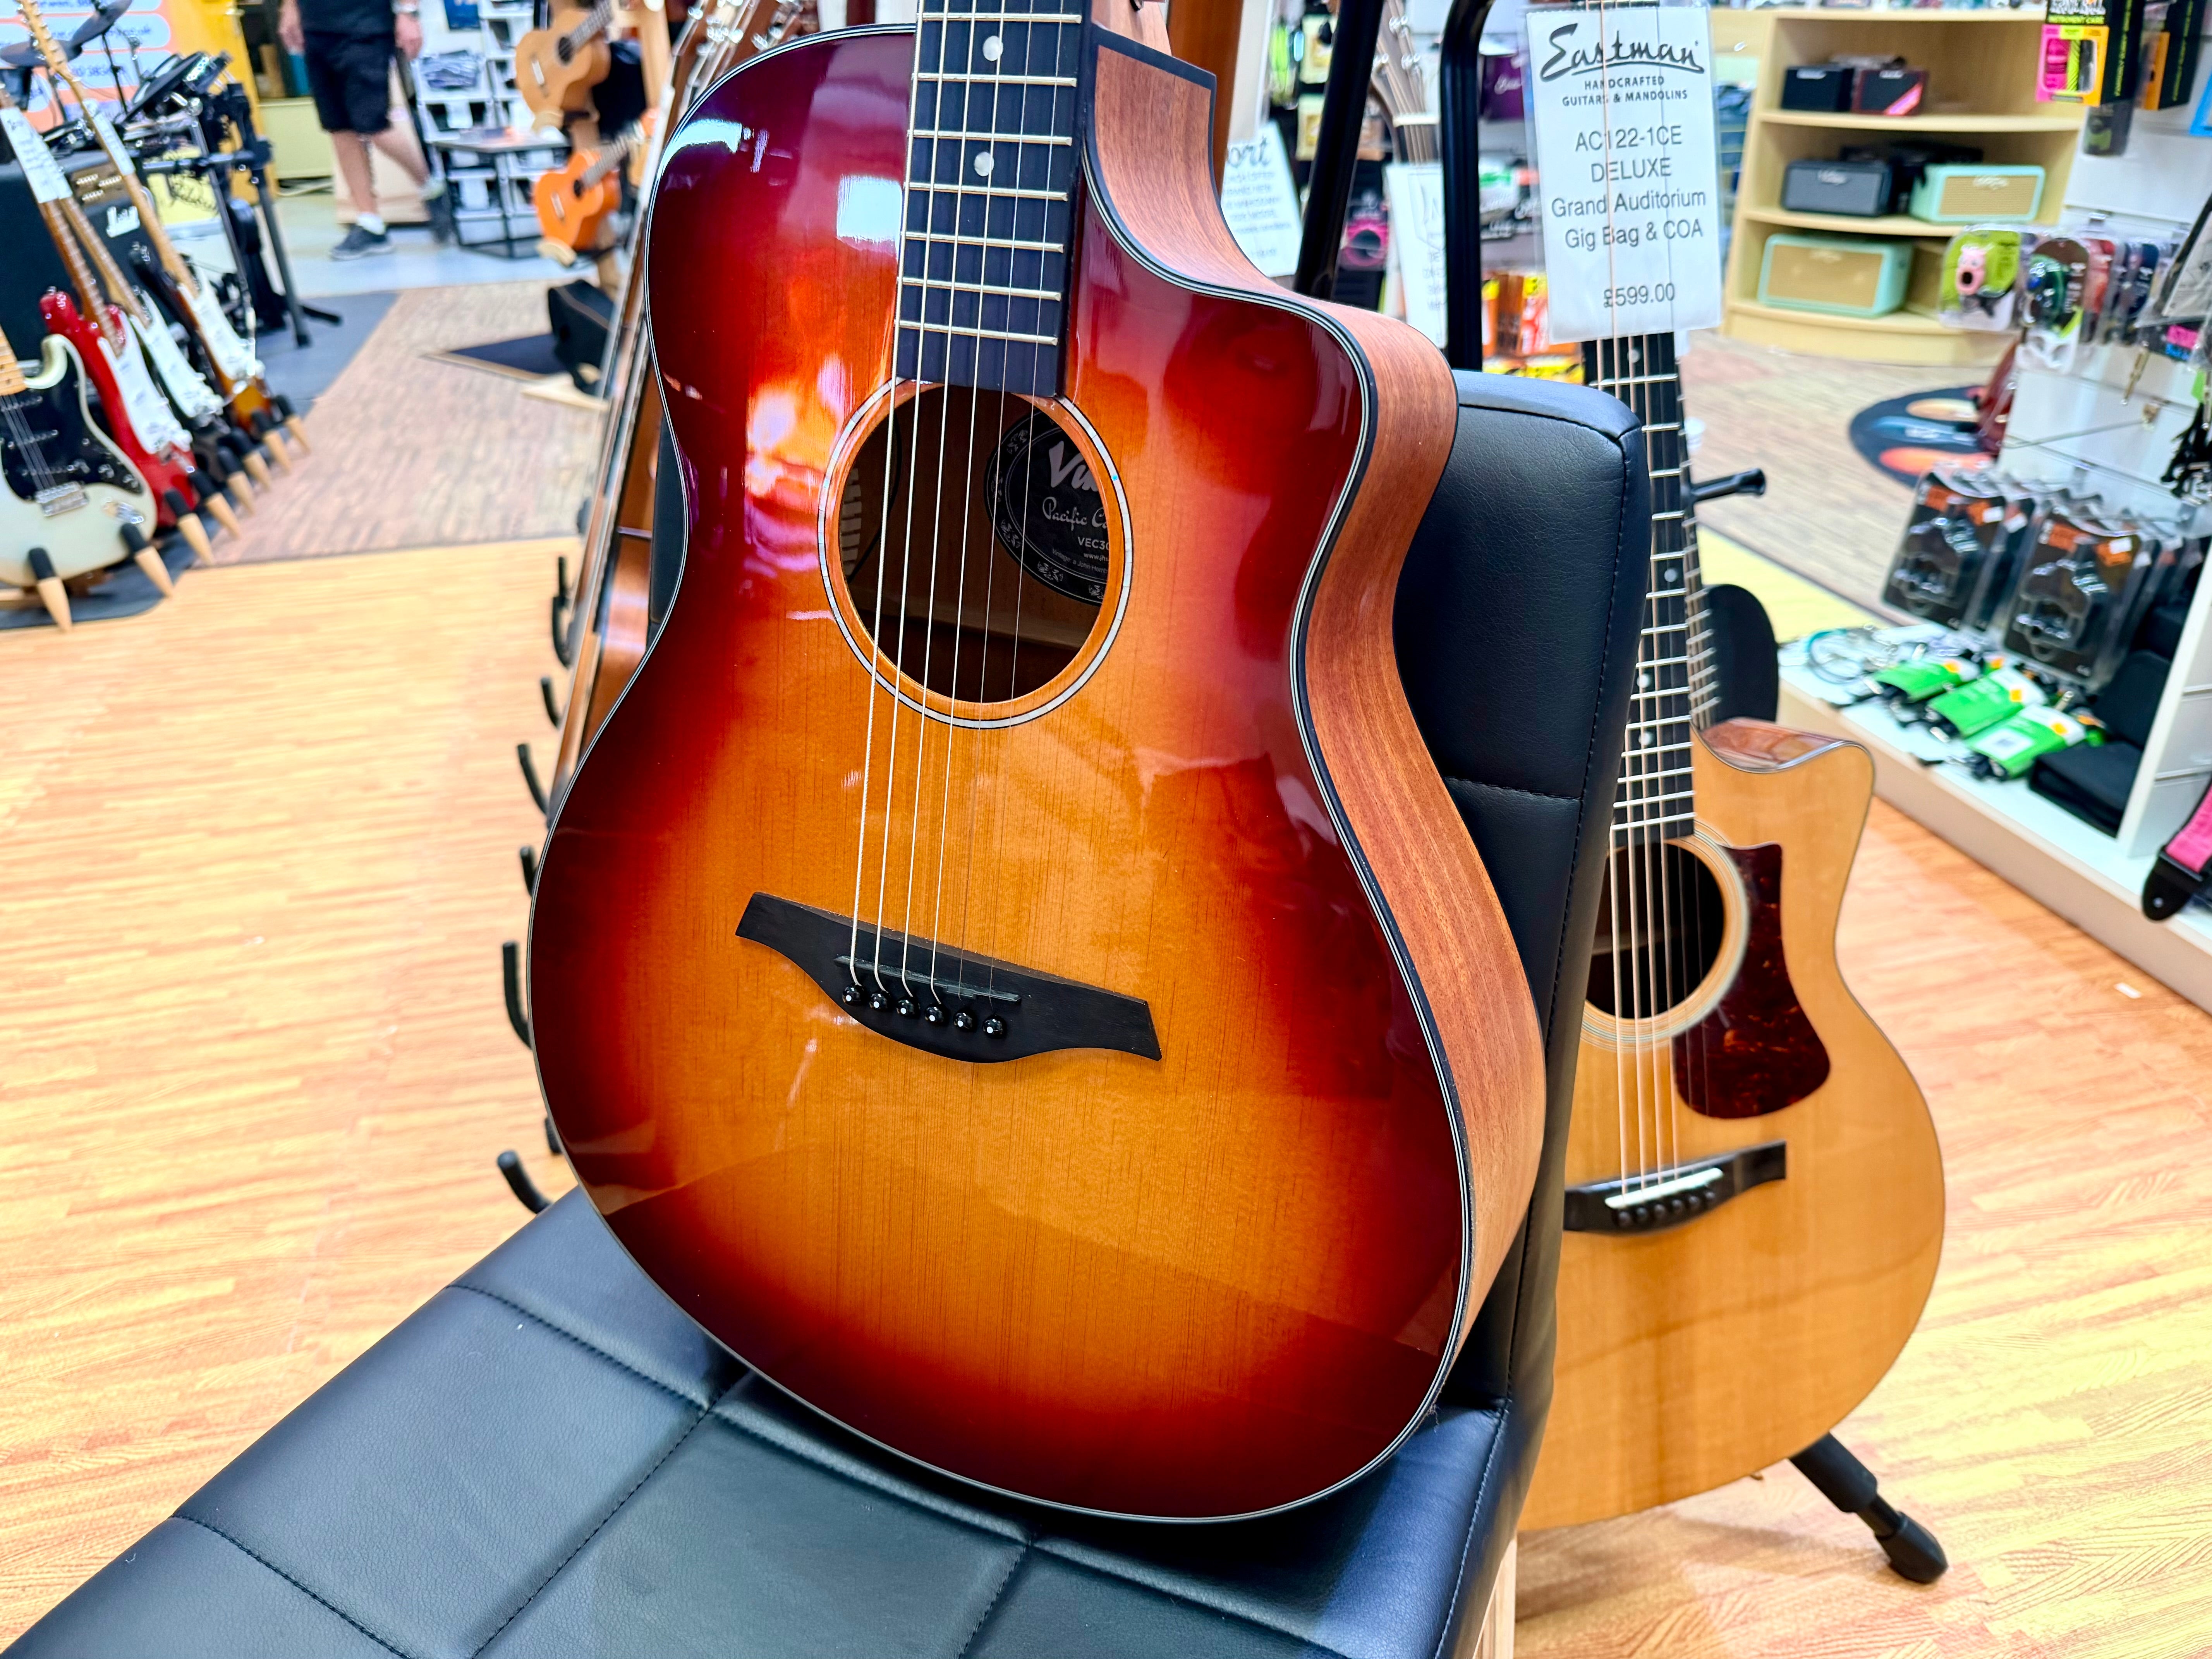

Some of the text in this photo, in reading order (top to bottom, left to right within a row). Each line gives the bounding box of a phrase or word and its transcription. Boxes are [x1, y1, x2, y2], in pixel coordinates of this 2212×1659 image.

[1540, 23, 1705, 82] Eastman
[1585, 76, 1664, 90] HANDCRAFTED
[1613, 93, 1621, 103] &
[1626, 90, 1687, 101] MANDOLINS
[1227, 136, 1271, 168] ort
[1575, 125, 1682, 152] AC122-1CE
[1592, 158, 1671, 182] DELUXE
[1552, 195, 1607, 218] Grand
[1614, 189, 1706, 212] Auditorium
[1565, 219, 1703, 252] Gig Bag & COA
[1604, 283, 1675, 308] £599.00
[1042, 497, 1088, 531] Pacific
[1077, 561, 1091, 570] John
